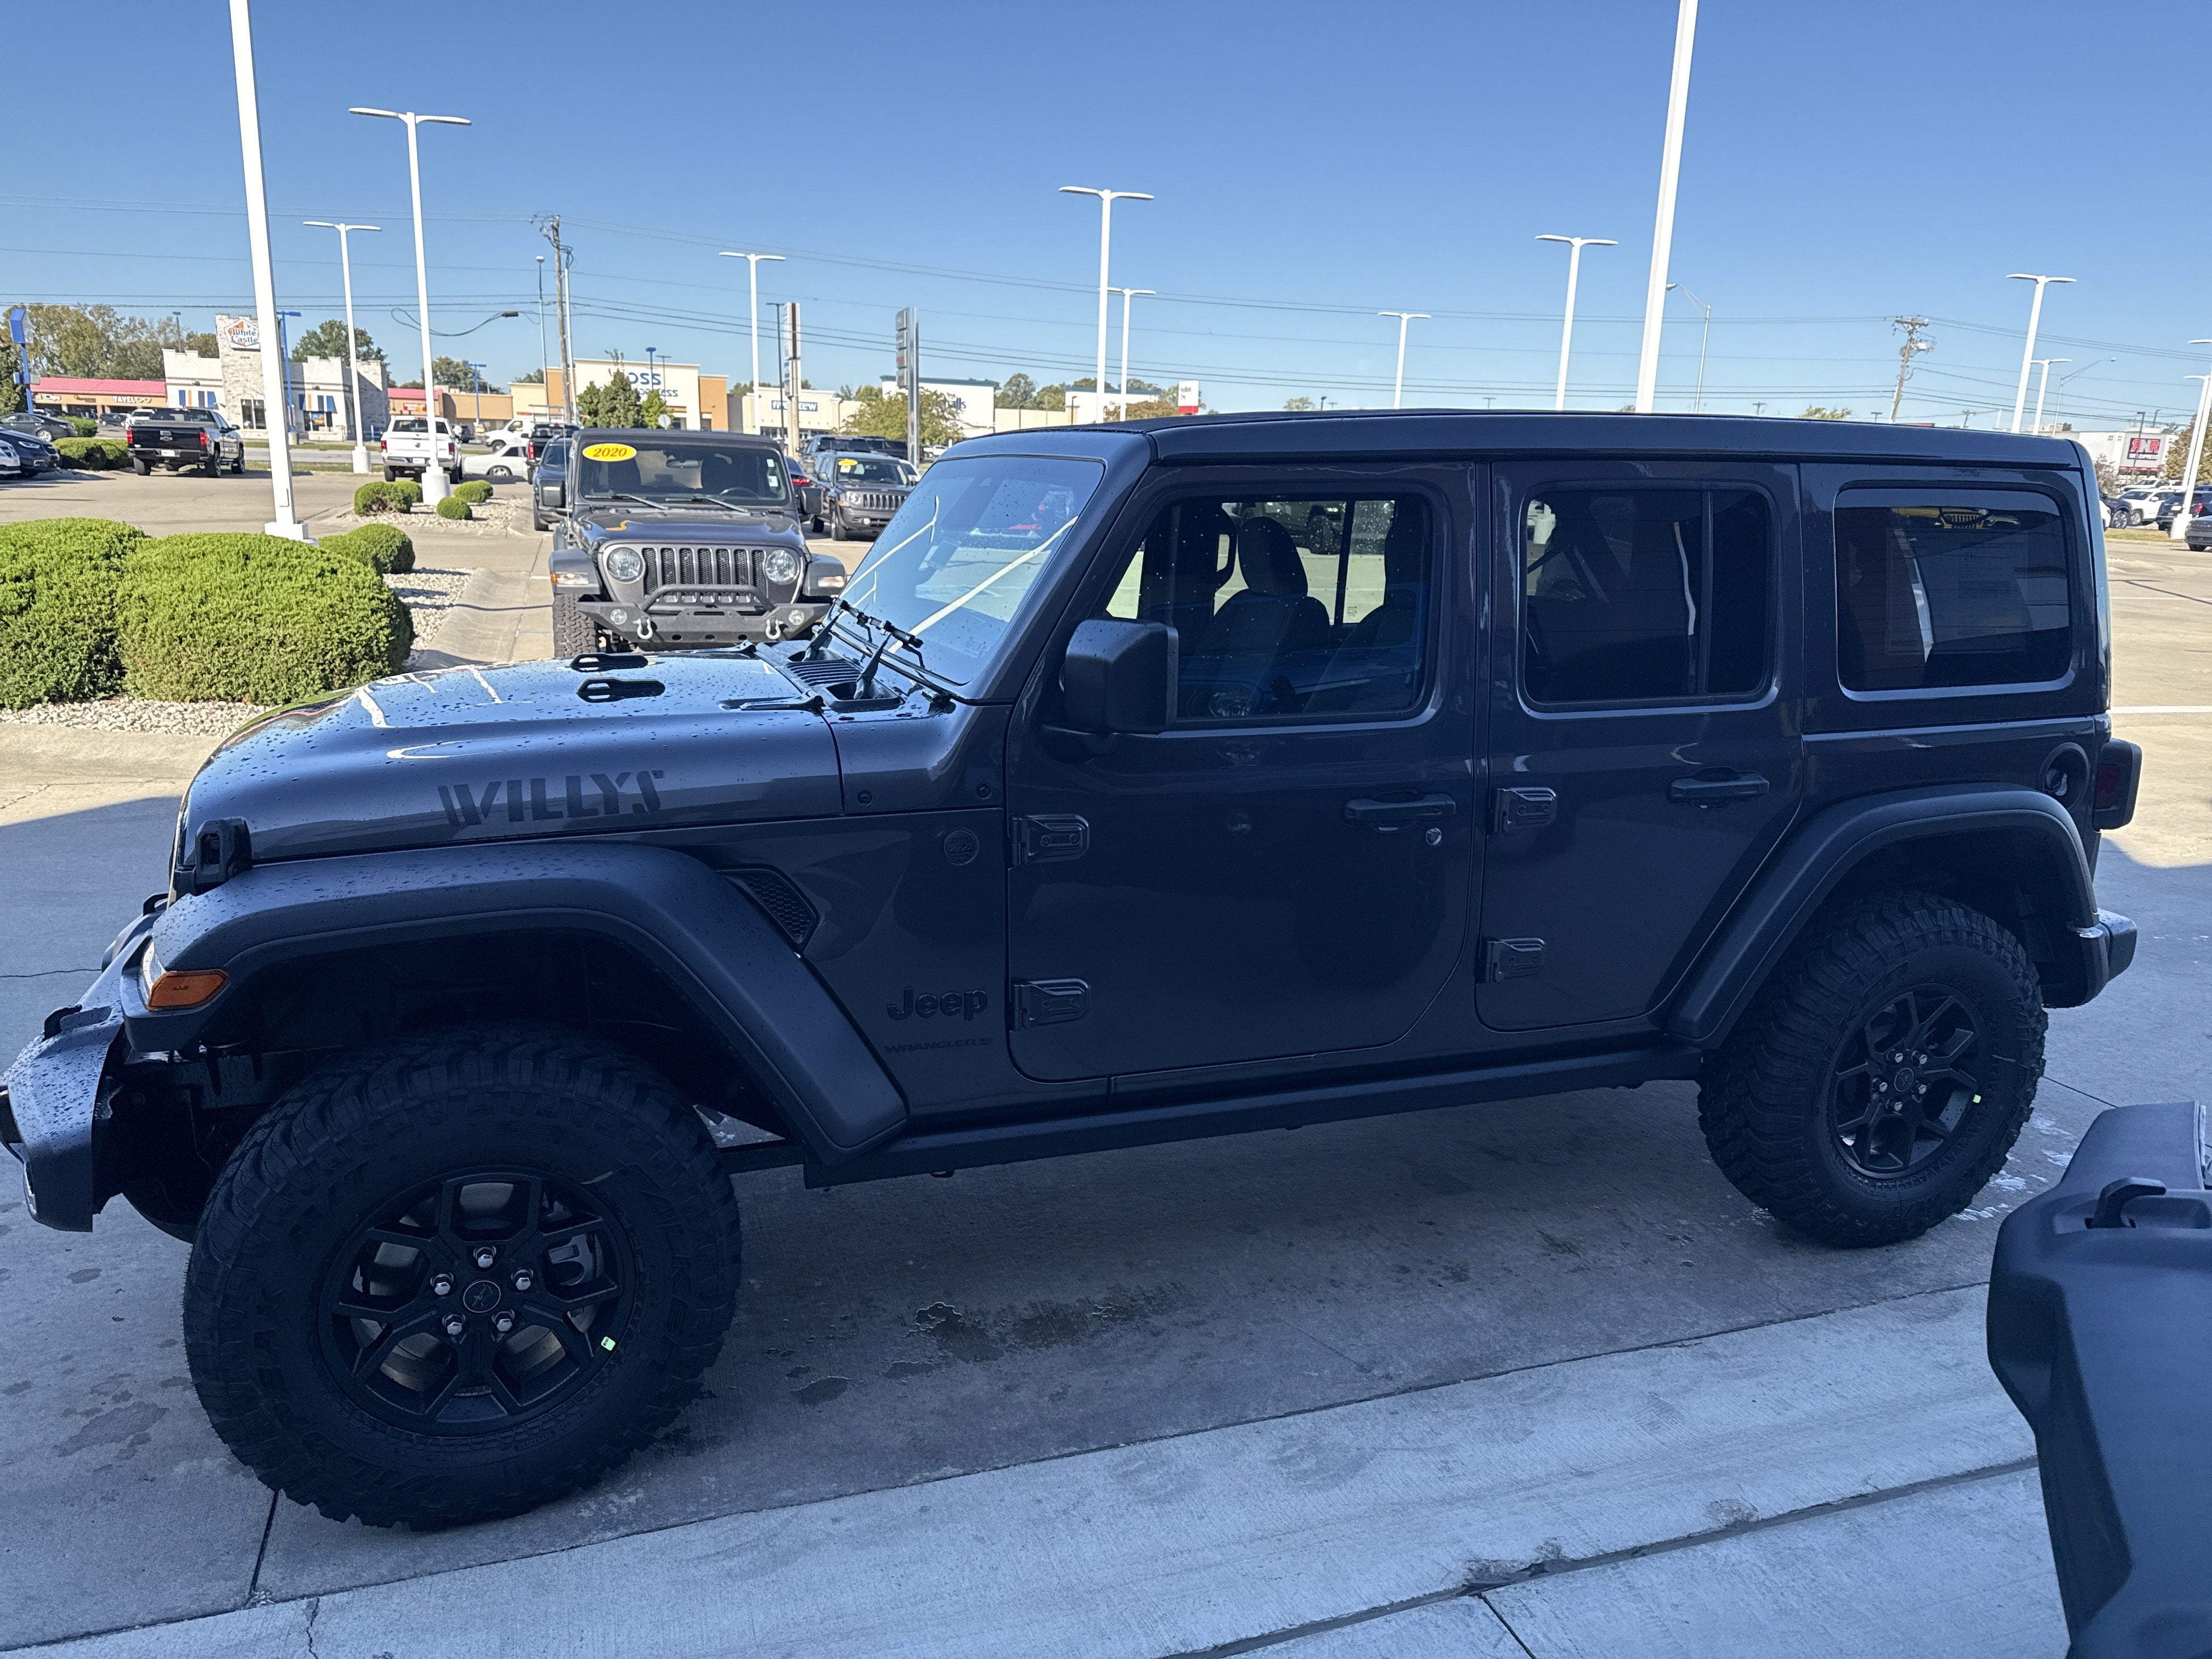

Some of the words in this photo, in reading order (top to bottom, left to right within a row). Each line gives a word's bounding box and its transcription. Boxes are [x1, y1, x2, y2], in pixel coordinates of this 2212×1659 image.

[592, 448, 628, 458] 2020
[437, 770, 664, 826] WILLYS
[887, 987, 988, 1021] Jeep
[884, 1038, 977, 1054] WRANGLER
